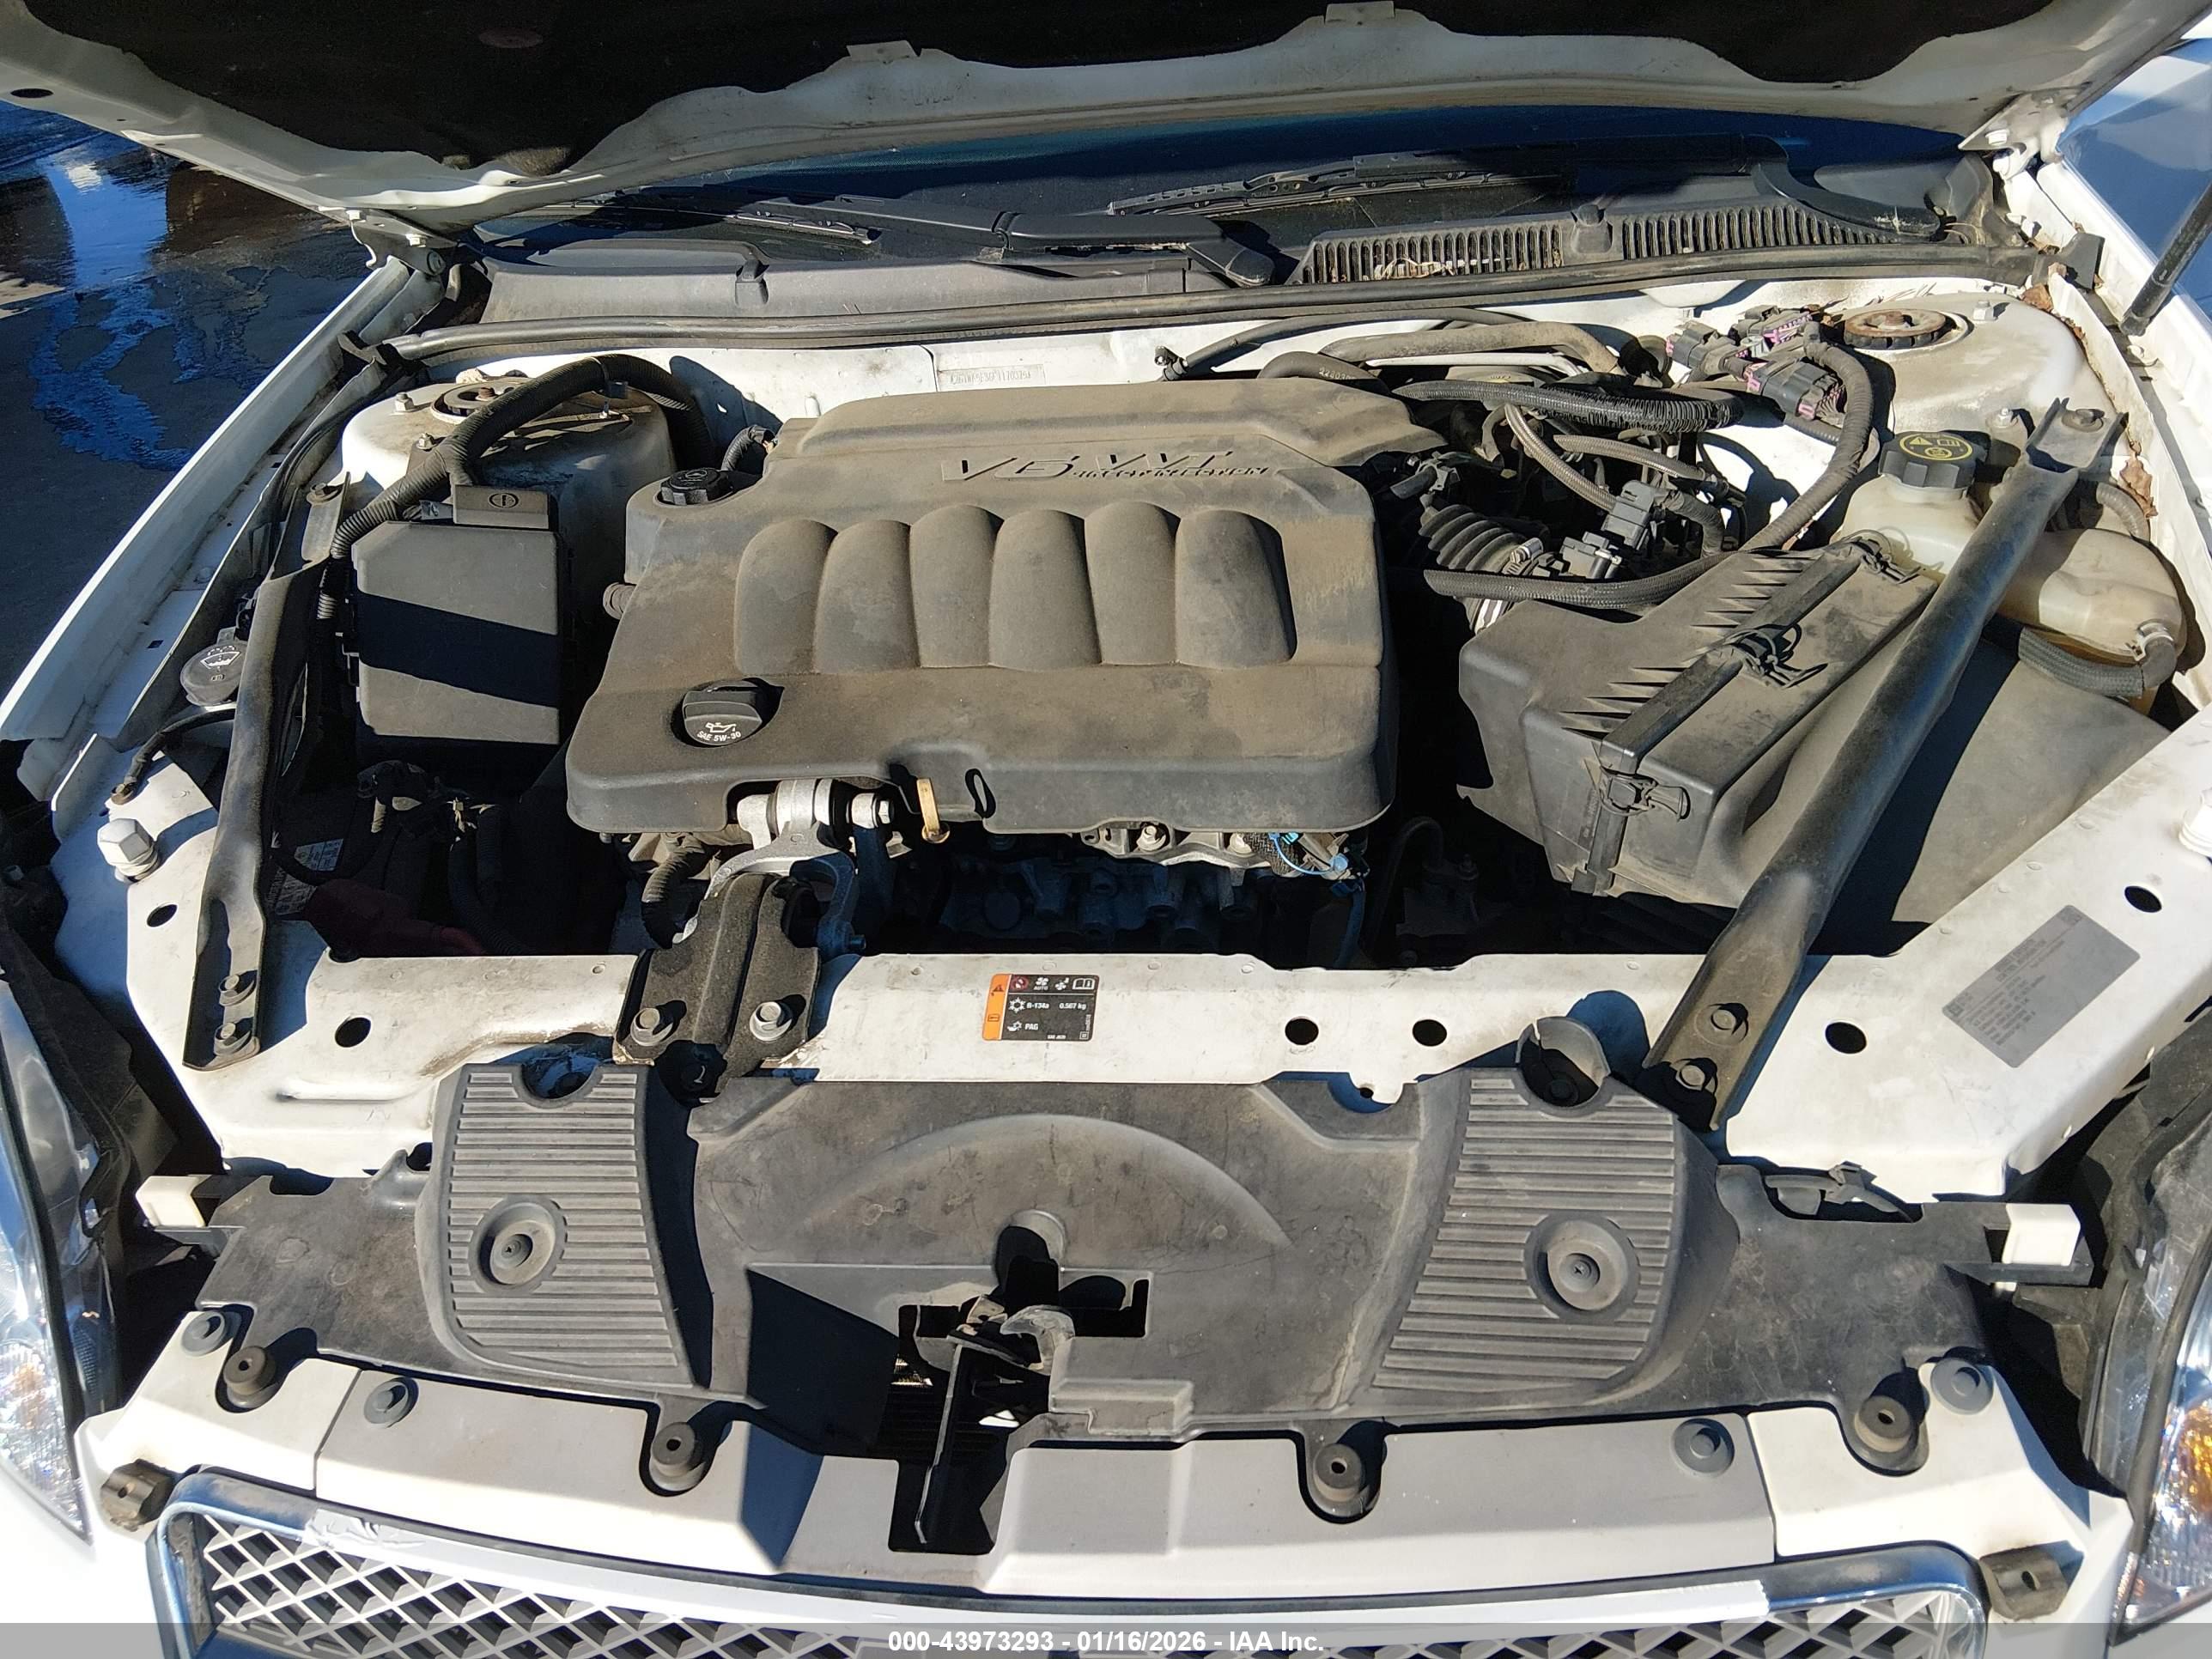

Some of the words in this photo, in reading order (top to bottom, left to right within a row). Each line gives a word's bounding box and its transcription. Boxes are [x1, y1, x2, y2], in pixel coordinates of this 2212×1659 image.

[941, 455, 1081, 481] V6
[1095, 451, 1234, 470] VVT
[697, 731, 712, 741] SAE
[714, 732, 741, 741] 5W-30
